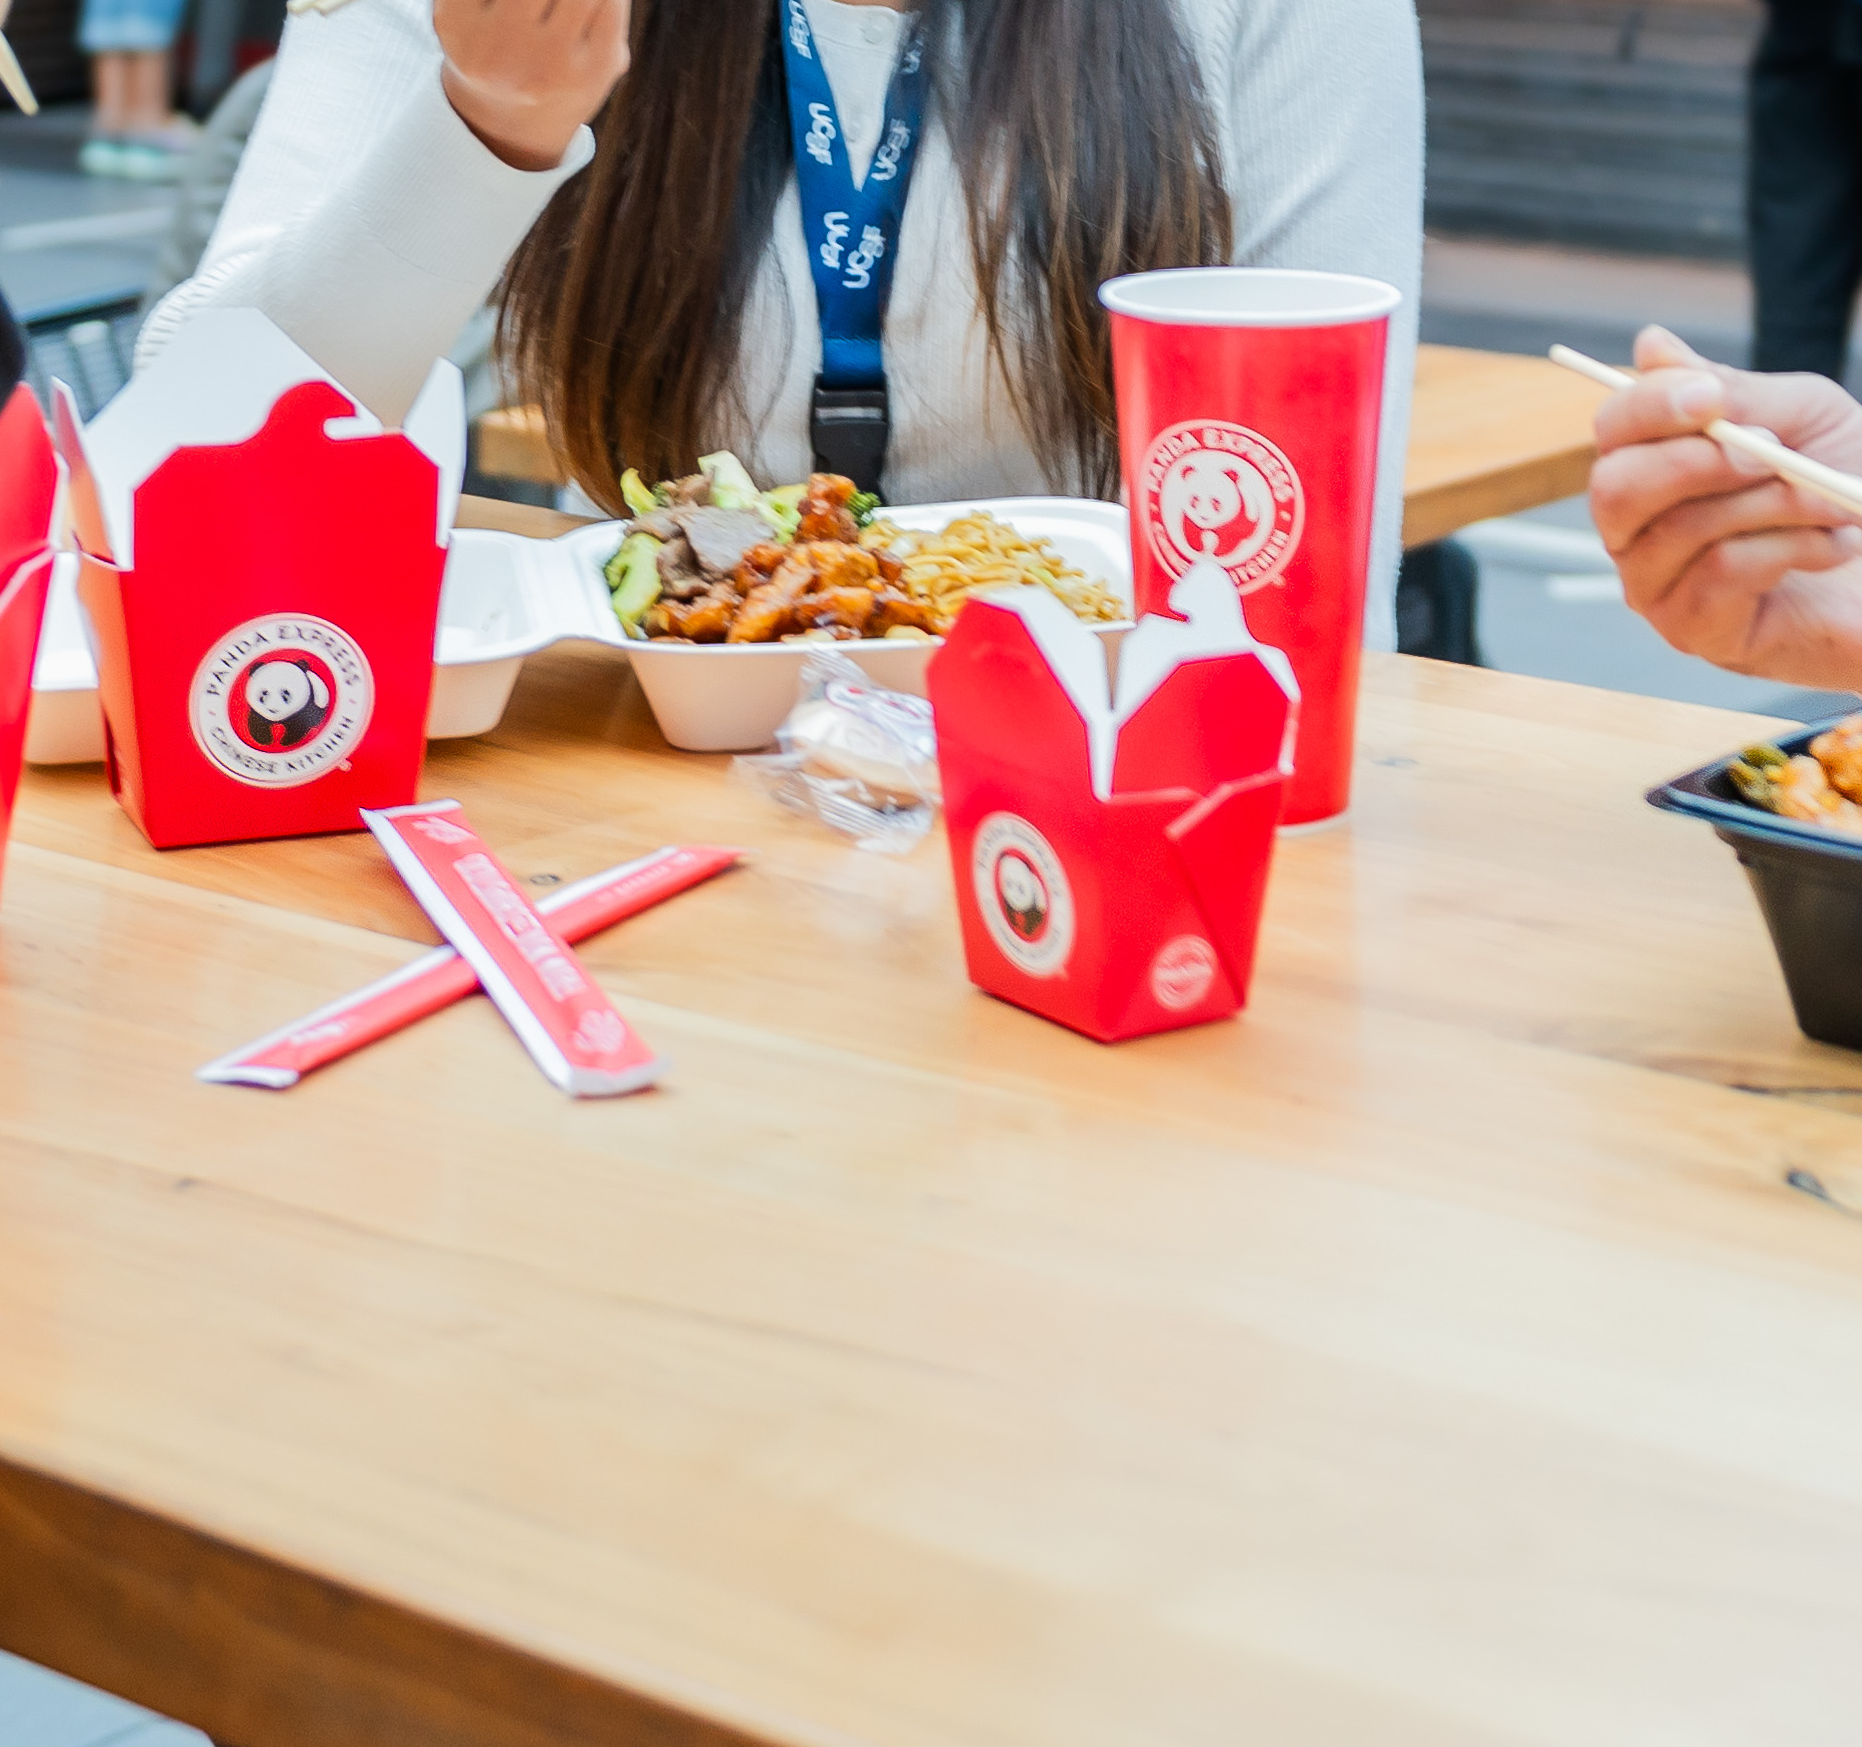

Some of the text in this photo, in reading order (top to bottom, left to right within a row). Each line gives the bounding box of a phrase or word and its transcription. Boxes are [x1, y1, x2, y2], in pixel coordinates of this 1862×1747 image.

[805, 102, 837, 166] UCSF
[842, 224, 886, 289] UCSF
[206, 624, 363, 697] PANDA EXPRESS
